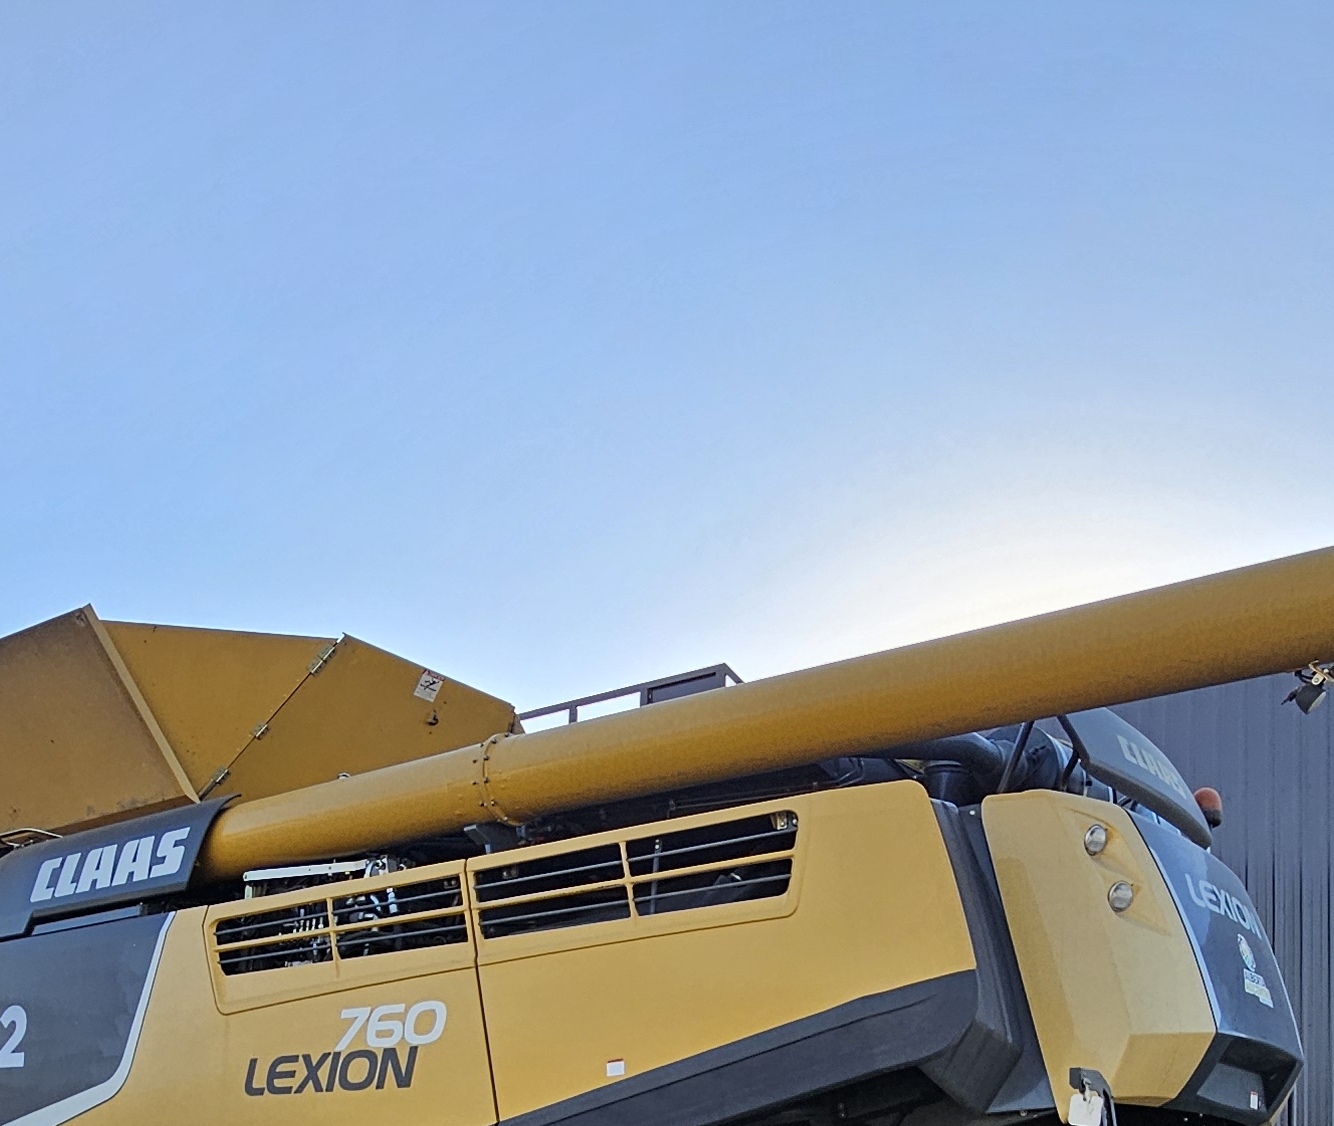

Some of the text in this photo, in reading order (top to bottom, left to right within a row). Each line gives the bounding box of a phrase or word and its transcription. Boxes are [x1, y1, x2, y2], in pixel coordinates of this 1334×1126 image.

[30, 826, 191, 903] CLAAS
[1184, 873, 1262, 940] LEXION
[334, 1000, 447, 1052] 760
[244, 1045, 419, 1097] LEXION
